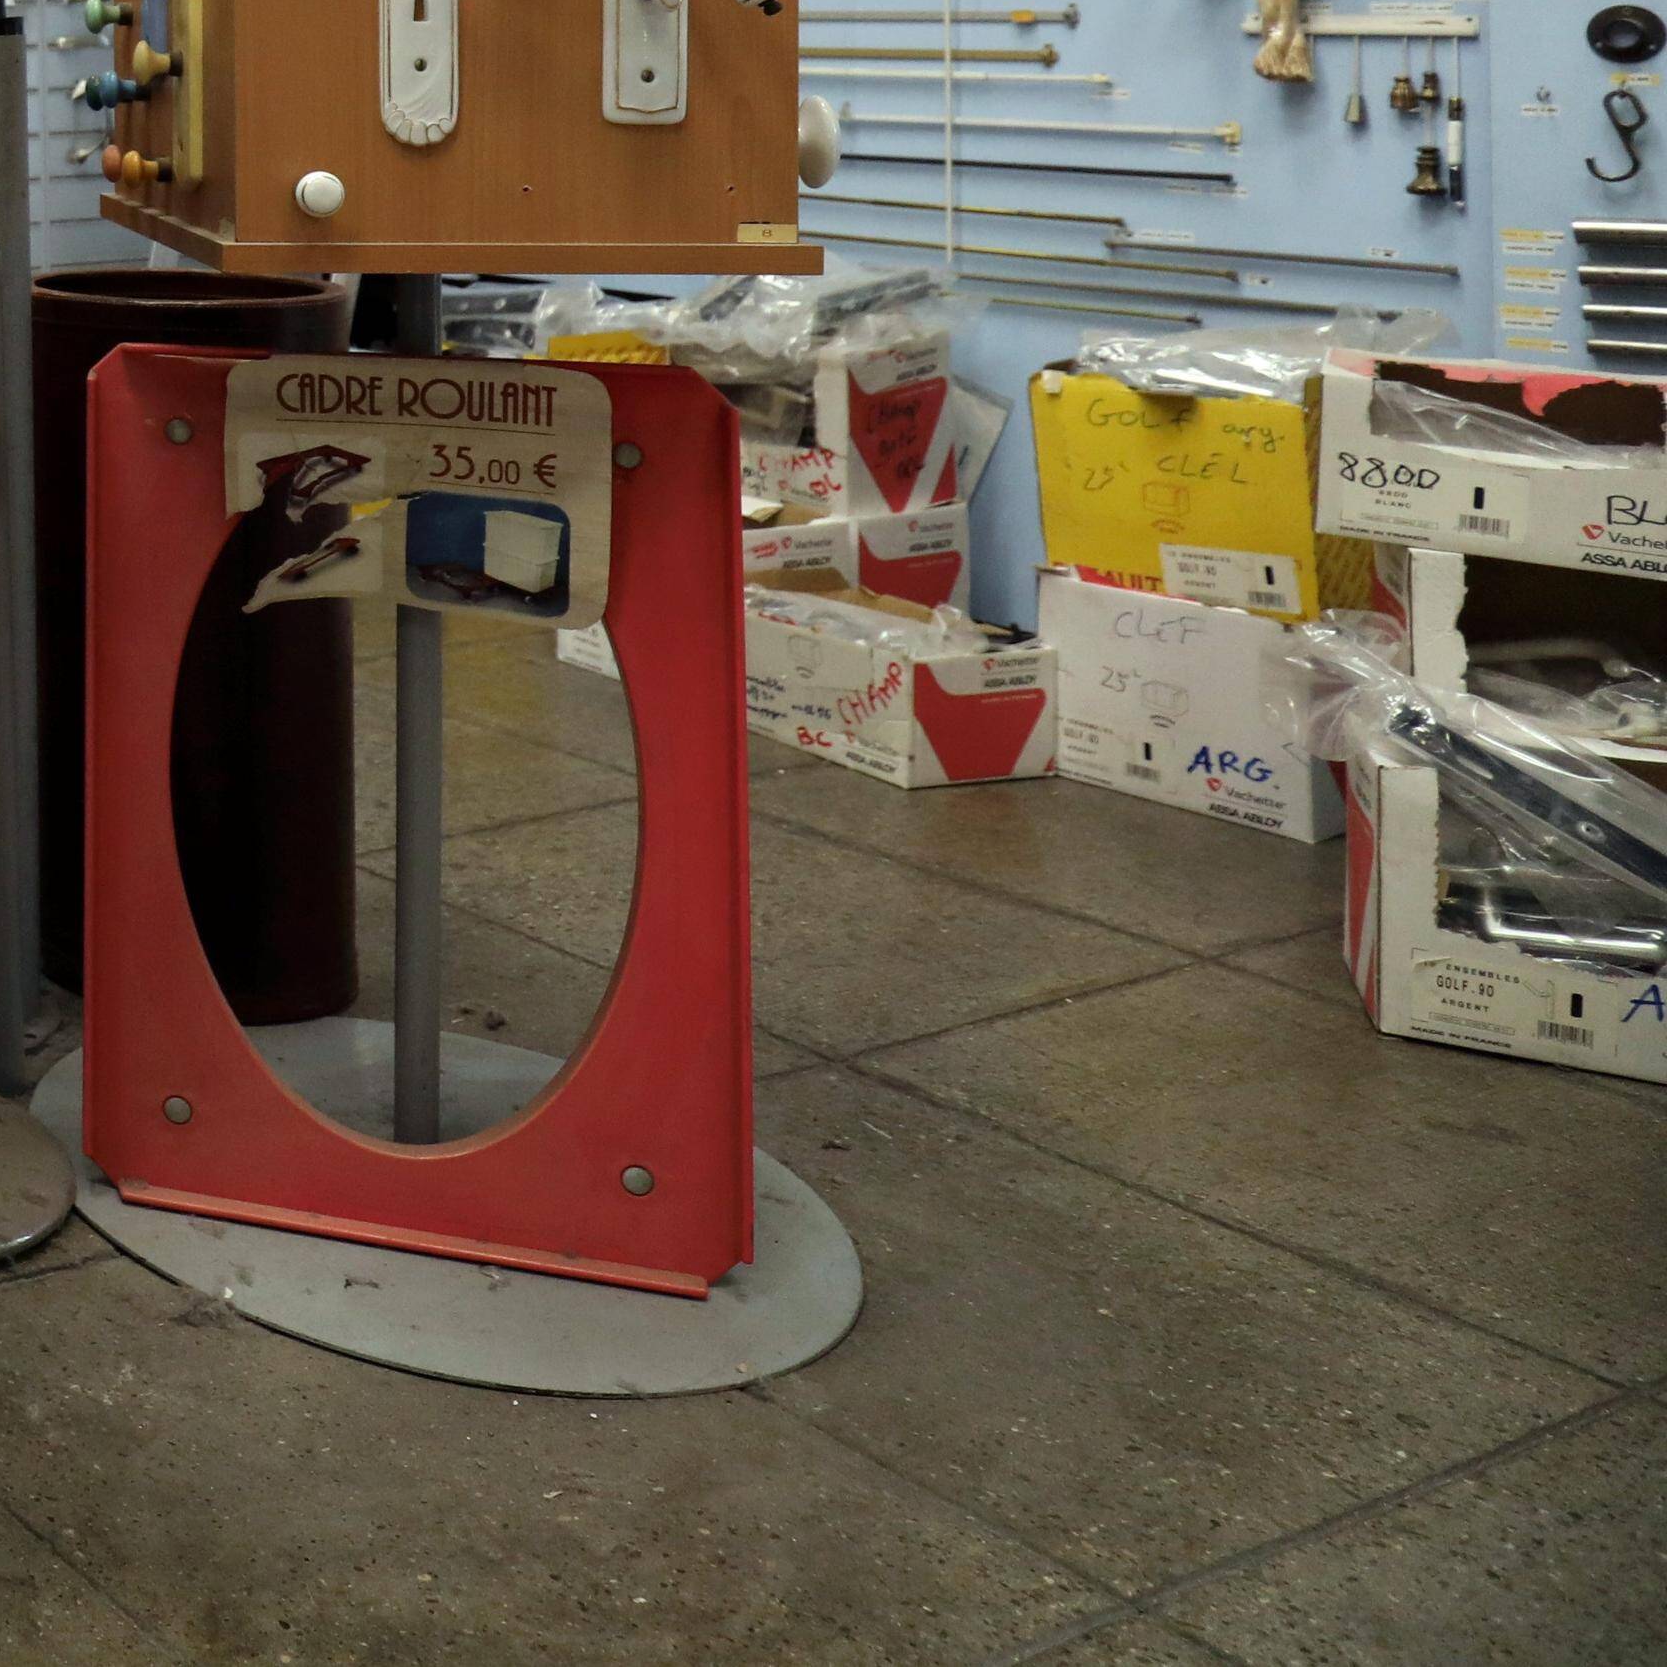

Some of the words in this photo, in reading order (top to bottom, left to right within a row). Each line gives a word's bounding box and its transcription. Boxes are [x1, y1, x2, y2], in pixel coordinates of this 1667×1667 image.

[275, 373, 383, 417] CADRE
[397, 378, 558, 427] ROULANT
[429, 444, 521, 485] 35,00
[533, 453, 557, 488] €
[1607, 495, 1667, 525] BL
[1581, 553, 1627, 569] ASSA
[1441, 997, 1490, 1013] ARGENT
